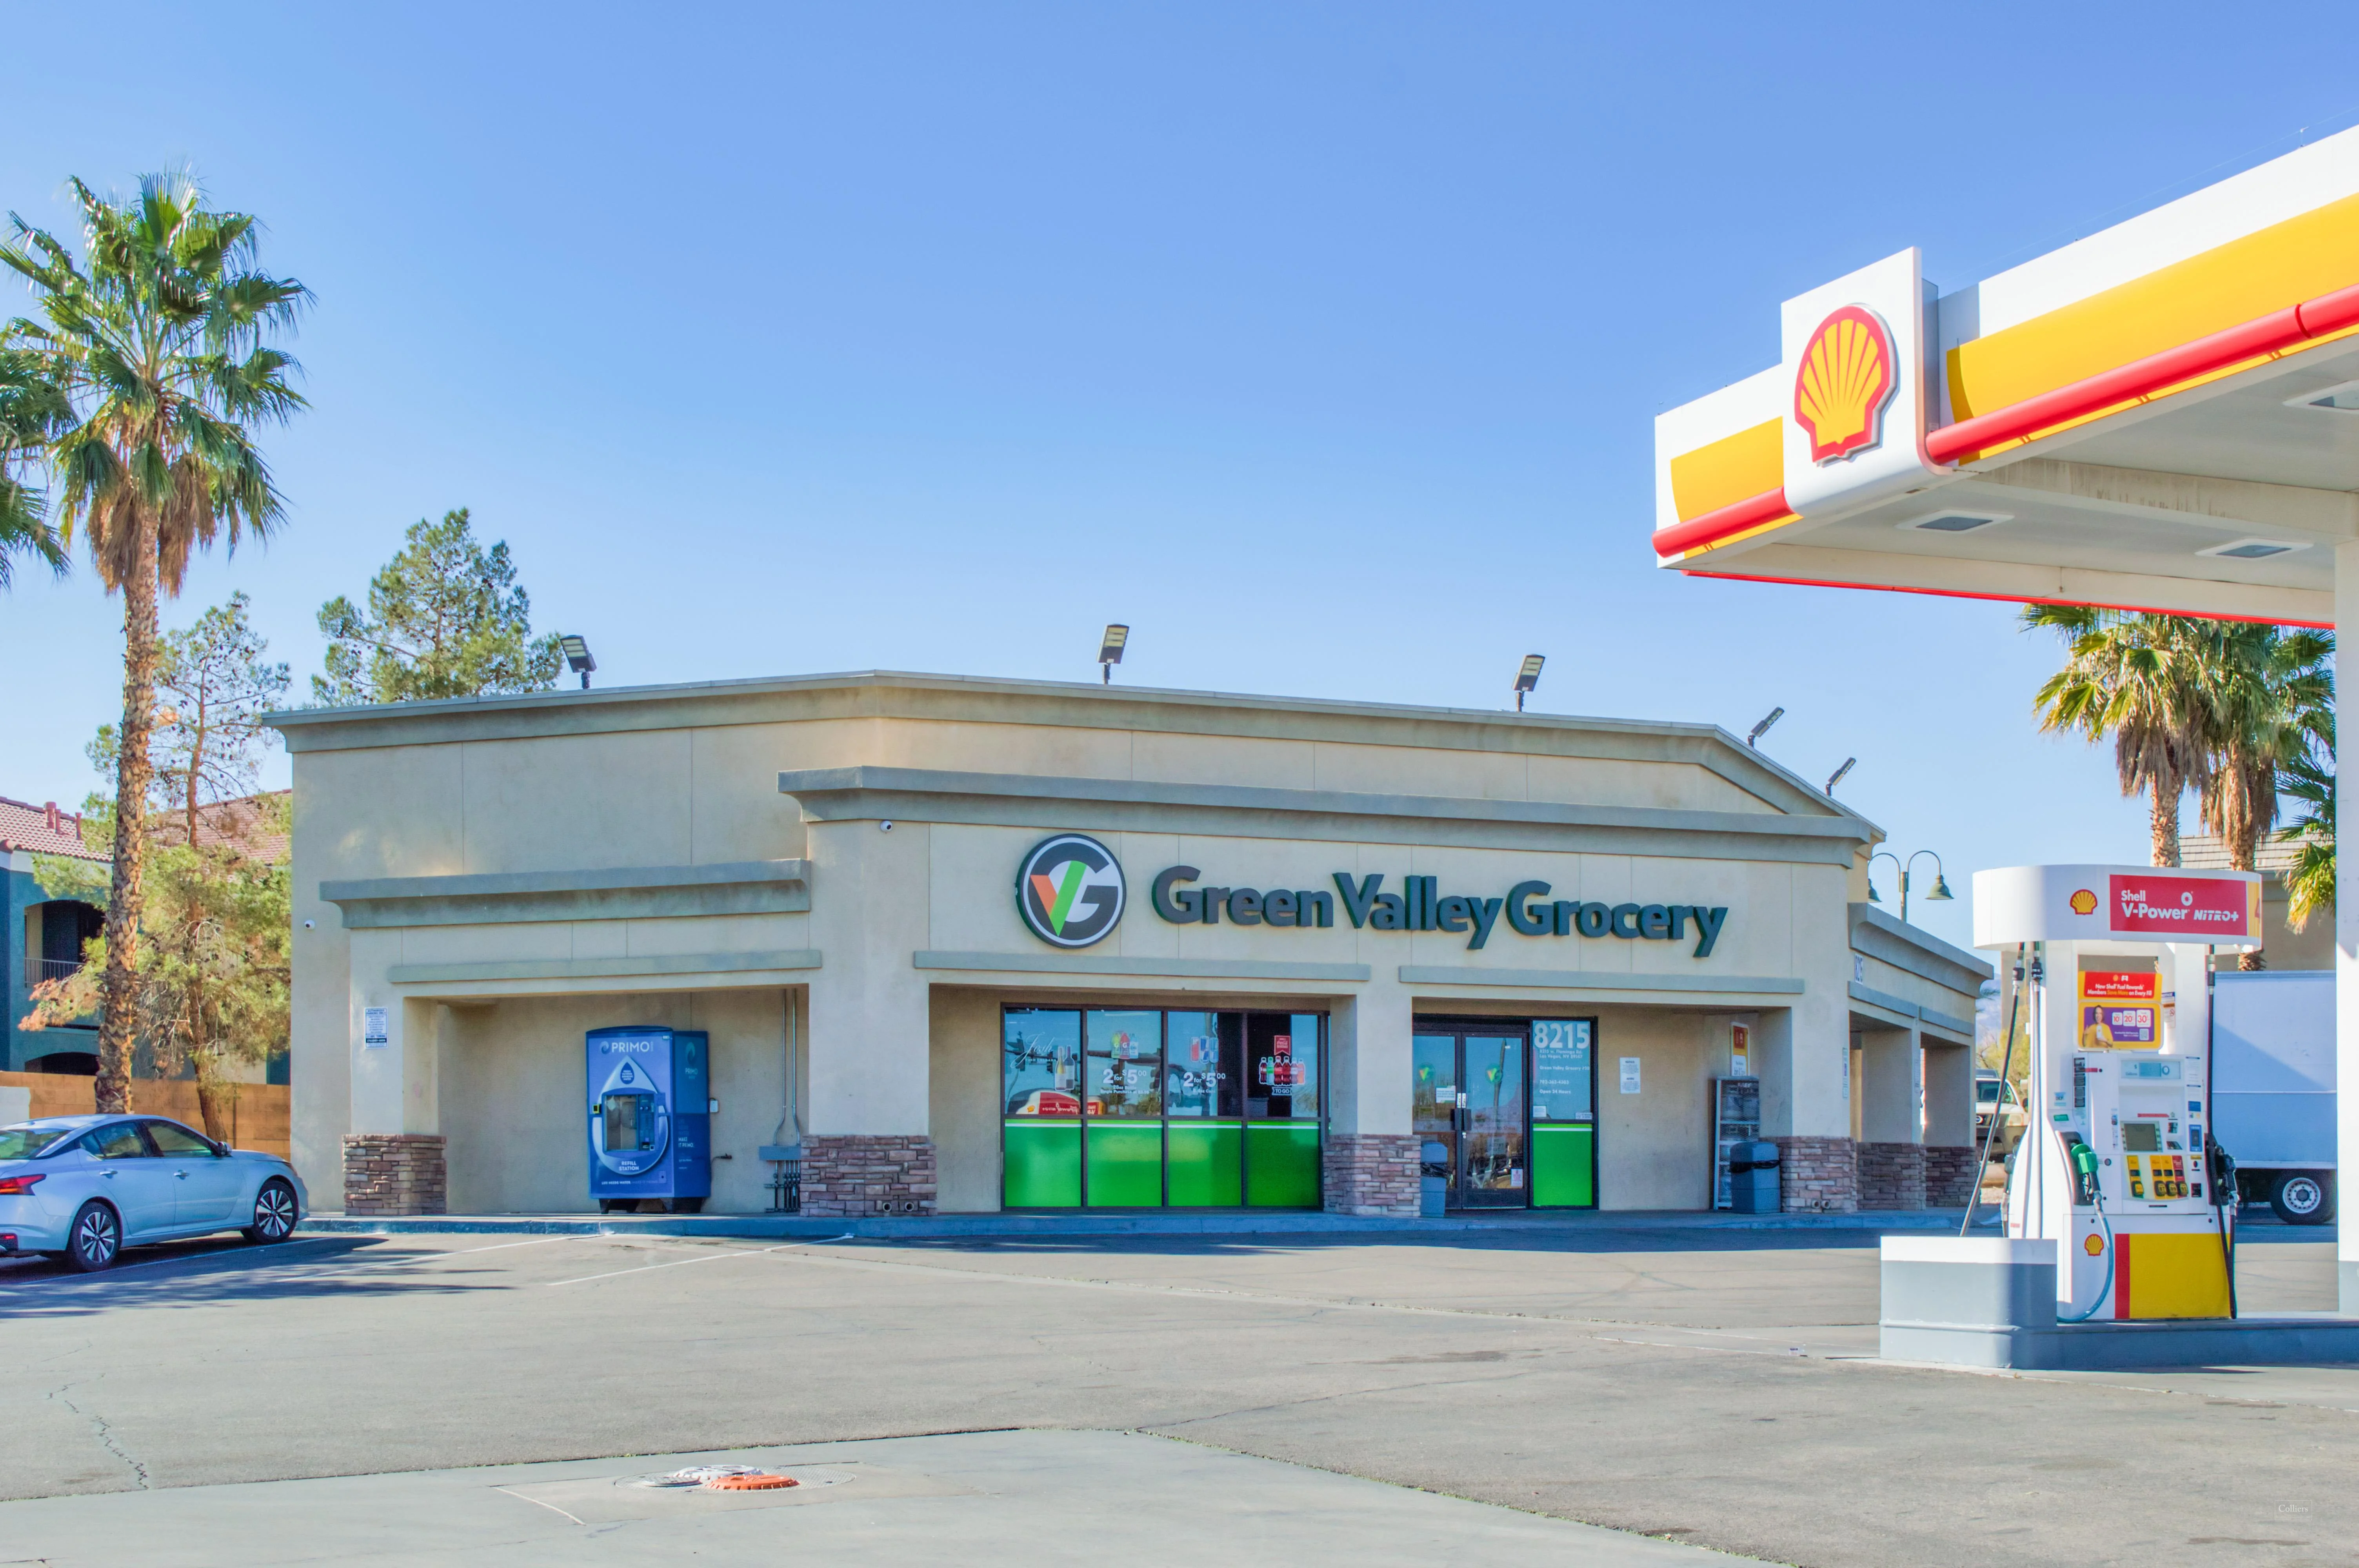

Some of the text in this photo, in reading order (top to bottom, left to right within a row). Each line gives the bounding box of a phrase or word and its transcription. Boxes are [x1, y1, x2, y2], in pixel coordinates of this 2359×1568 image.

[2121, 889, 2146, 902] Shell
[1151, 865, 1728, 958] Green Valley Grocery
[2121, 902, 2188, 920] V-Power
[1534, 1022, 1590, 1049] 8215
[611, 1041, 650, 1053] PRIMO
[1103, 1068, 1114, 1083] 2
[1183, 1072, 1194, 1087] 2
